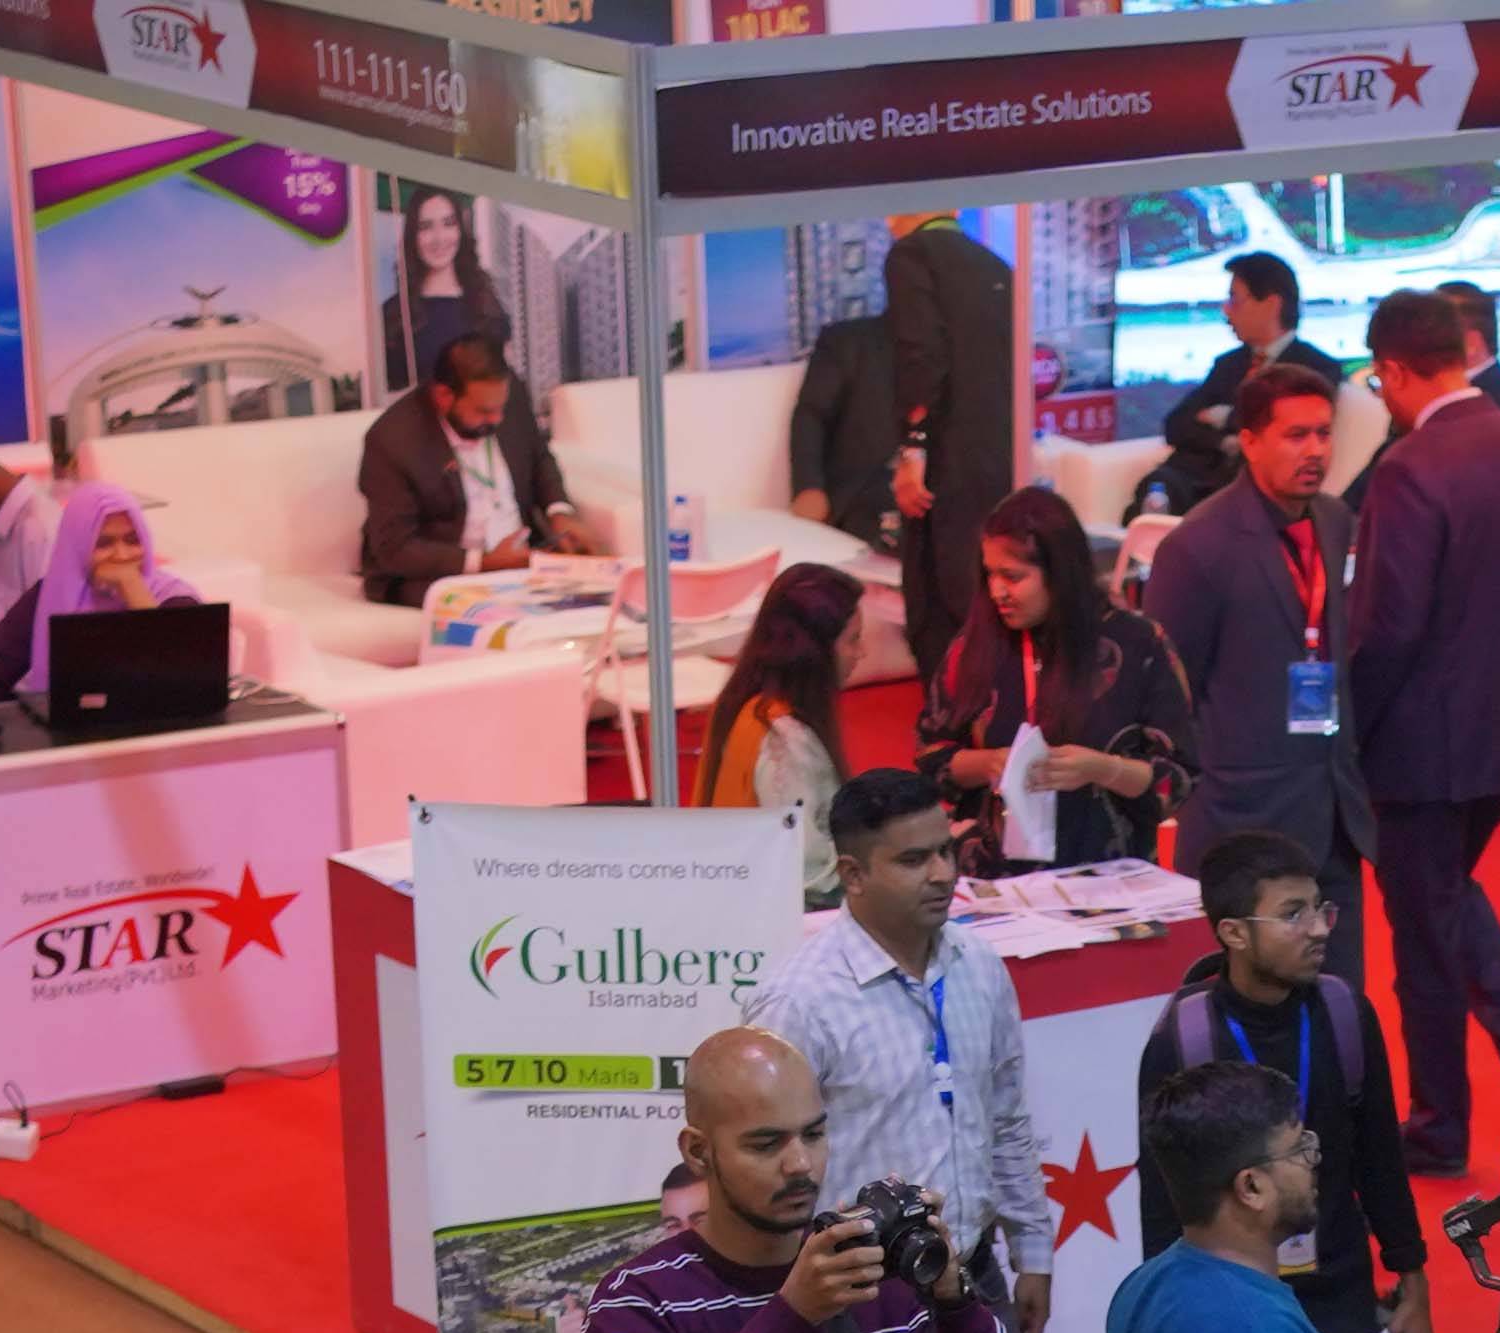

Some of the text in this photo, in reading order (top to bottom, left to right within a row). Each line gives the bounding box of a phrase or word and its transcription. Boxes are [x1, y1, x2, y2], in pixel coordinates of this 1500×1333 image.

[130, 13, 191, 57] STAR
[314, 39, 467, 116] 111-111-160
[1287, 68, 1377, 107] STAR
[731, 88, 1152, 154] Innovative Real-Estate Solutions
[472, 857, 750, 882] Where dreams come home
[30, 908, 199, 981] STAR
[520, 925, 766, 1008] Gulberg
[587, 990, 700, 1009] Islamabad
[466, 1059, 485, 1084] 5
[496, 1060, 516, 1084] 7
[532, 1060, 568, 1084] 10
[527, 1104, 642, 1121] RESIDENTIAL
